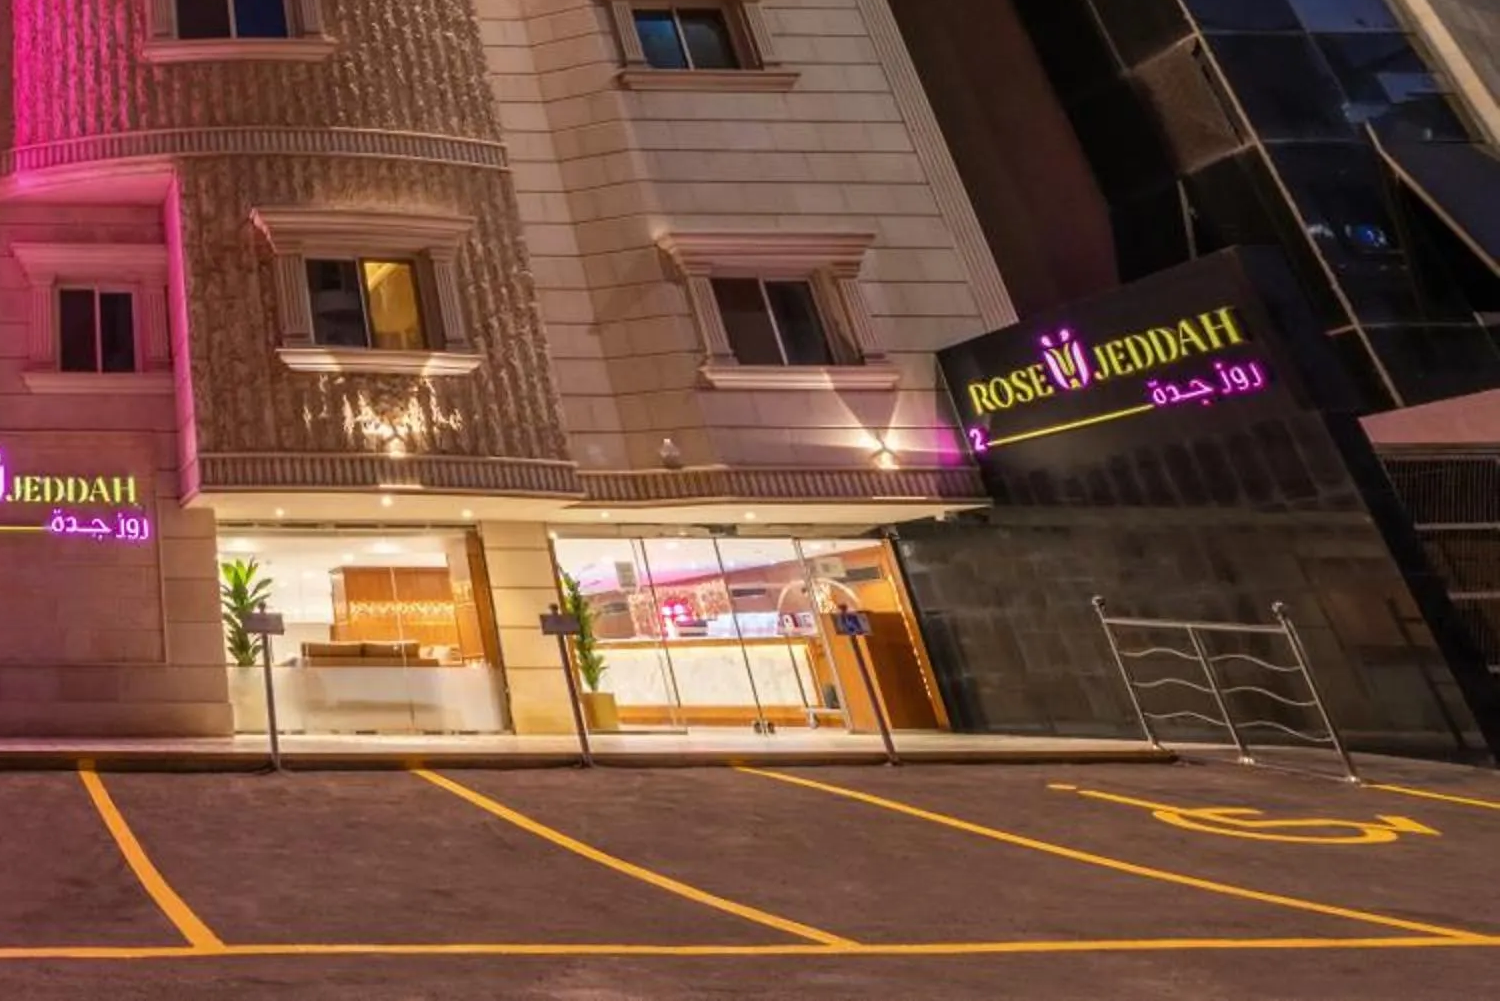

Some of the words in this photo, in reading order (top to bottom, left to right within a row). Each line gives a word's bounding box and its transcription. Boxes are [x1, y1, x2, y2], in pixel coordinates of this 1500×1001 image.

[968, 363, 1054, 416] ROSE
[1093, 306, 1244, 381] JEDDAH
[1214, 361, 1264, 395] روز
[968, 428, 988, 451] 2
[5, 475, 137, 504] JEDDAH
[115, 511, 150, 540] روز
